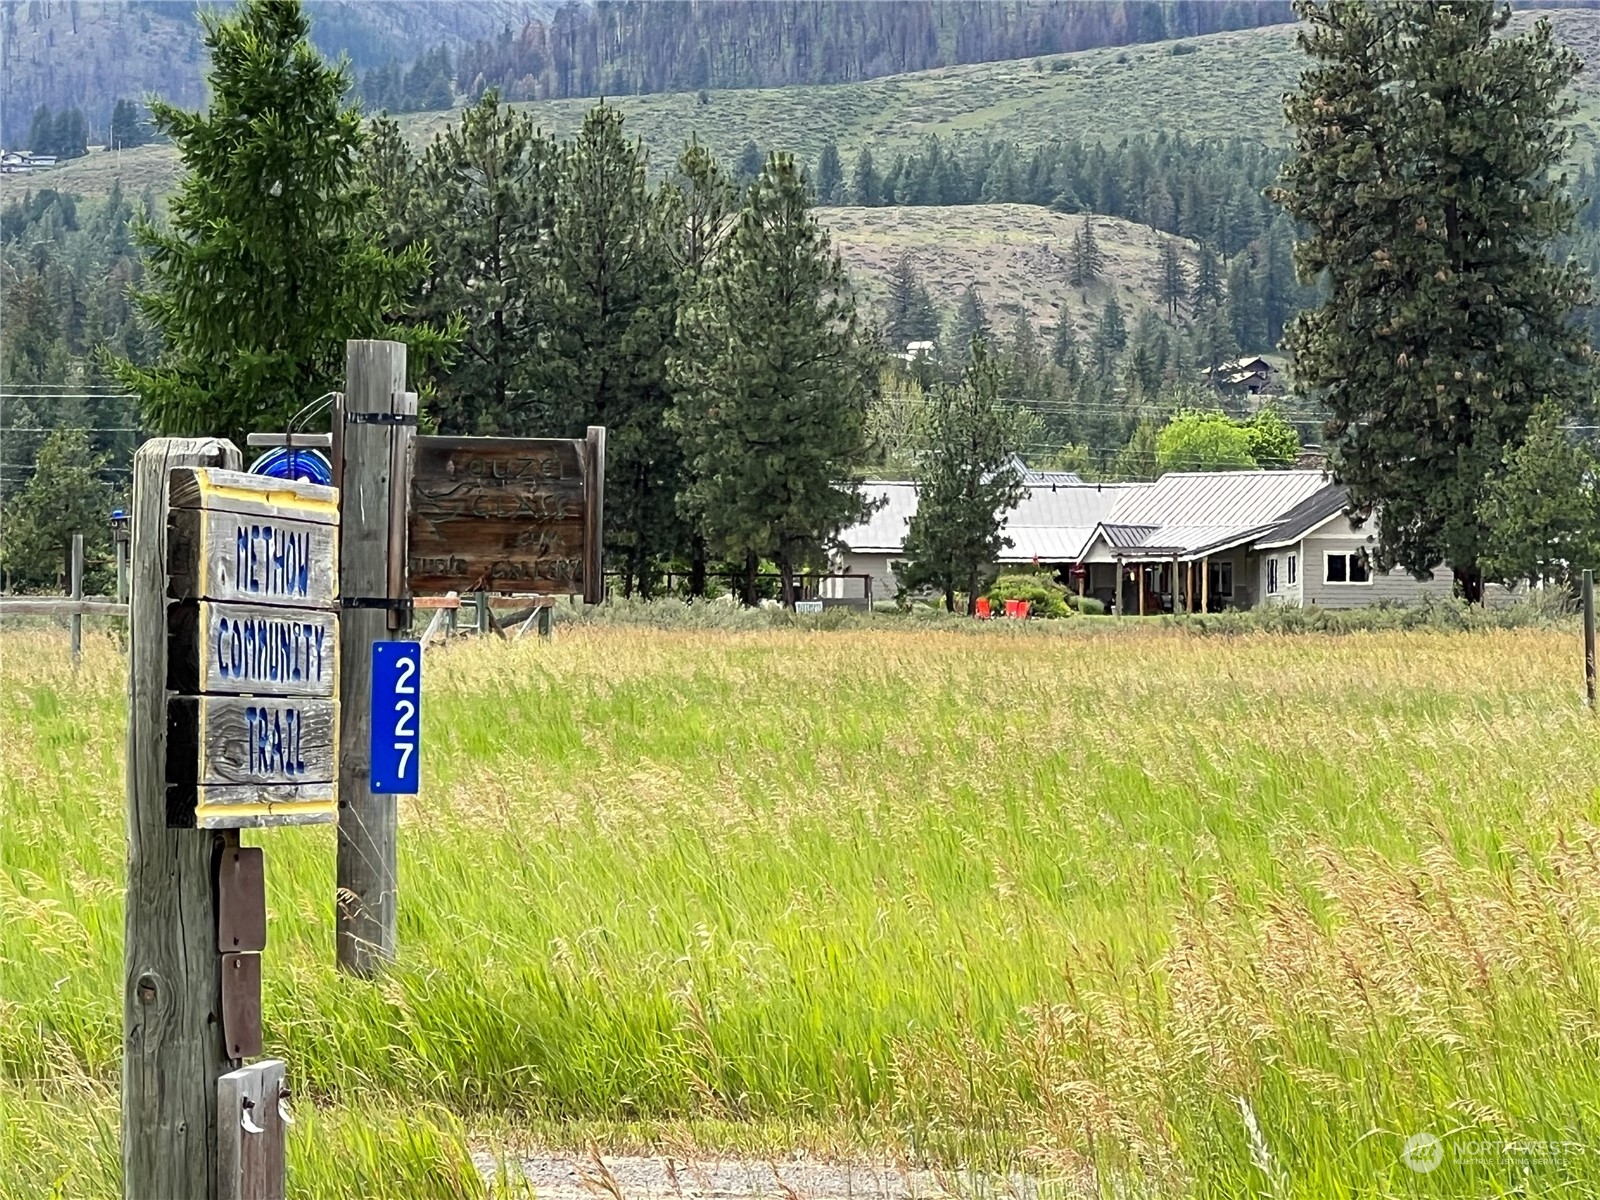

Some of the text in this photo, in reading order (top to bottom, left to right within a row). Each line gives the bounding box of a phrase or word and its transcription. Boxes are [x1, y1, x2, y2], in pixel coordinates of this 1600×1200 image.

[236, 525, 310, 598] METHOW
[217, 617, 325, 684] COMMUNITY
[244, 706, 305, 776] TRAIL
[394, 657, 416, 779] 227
